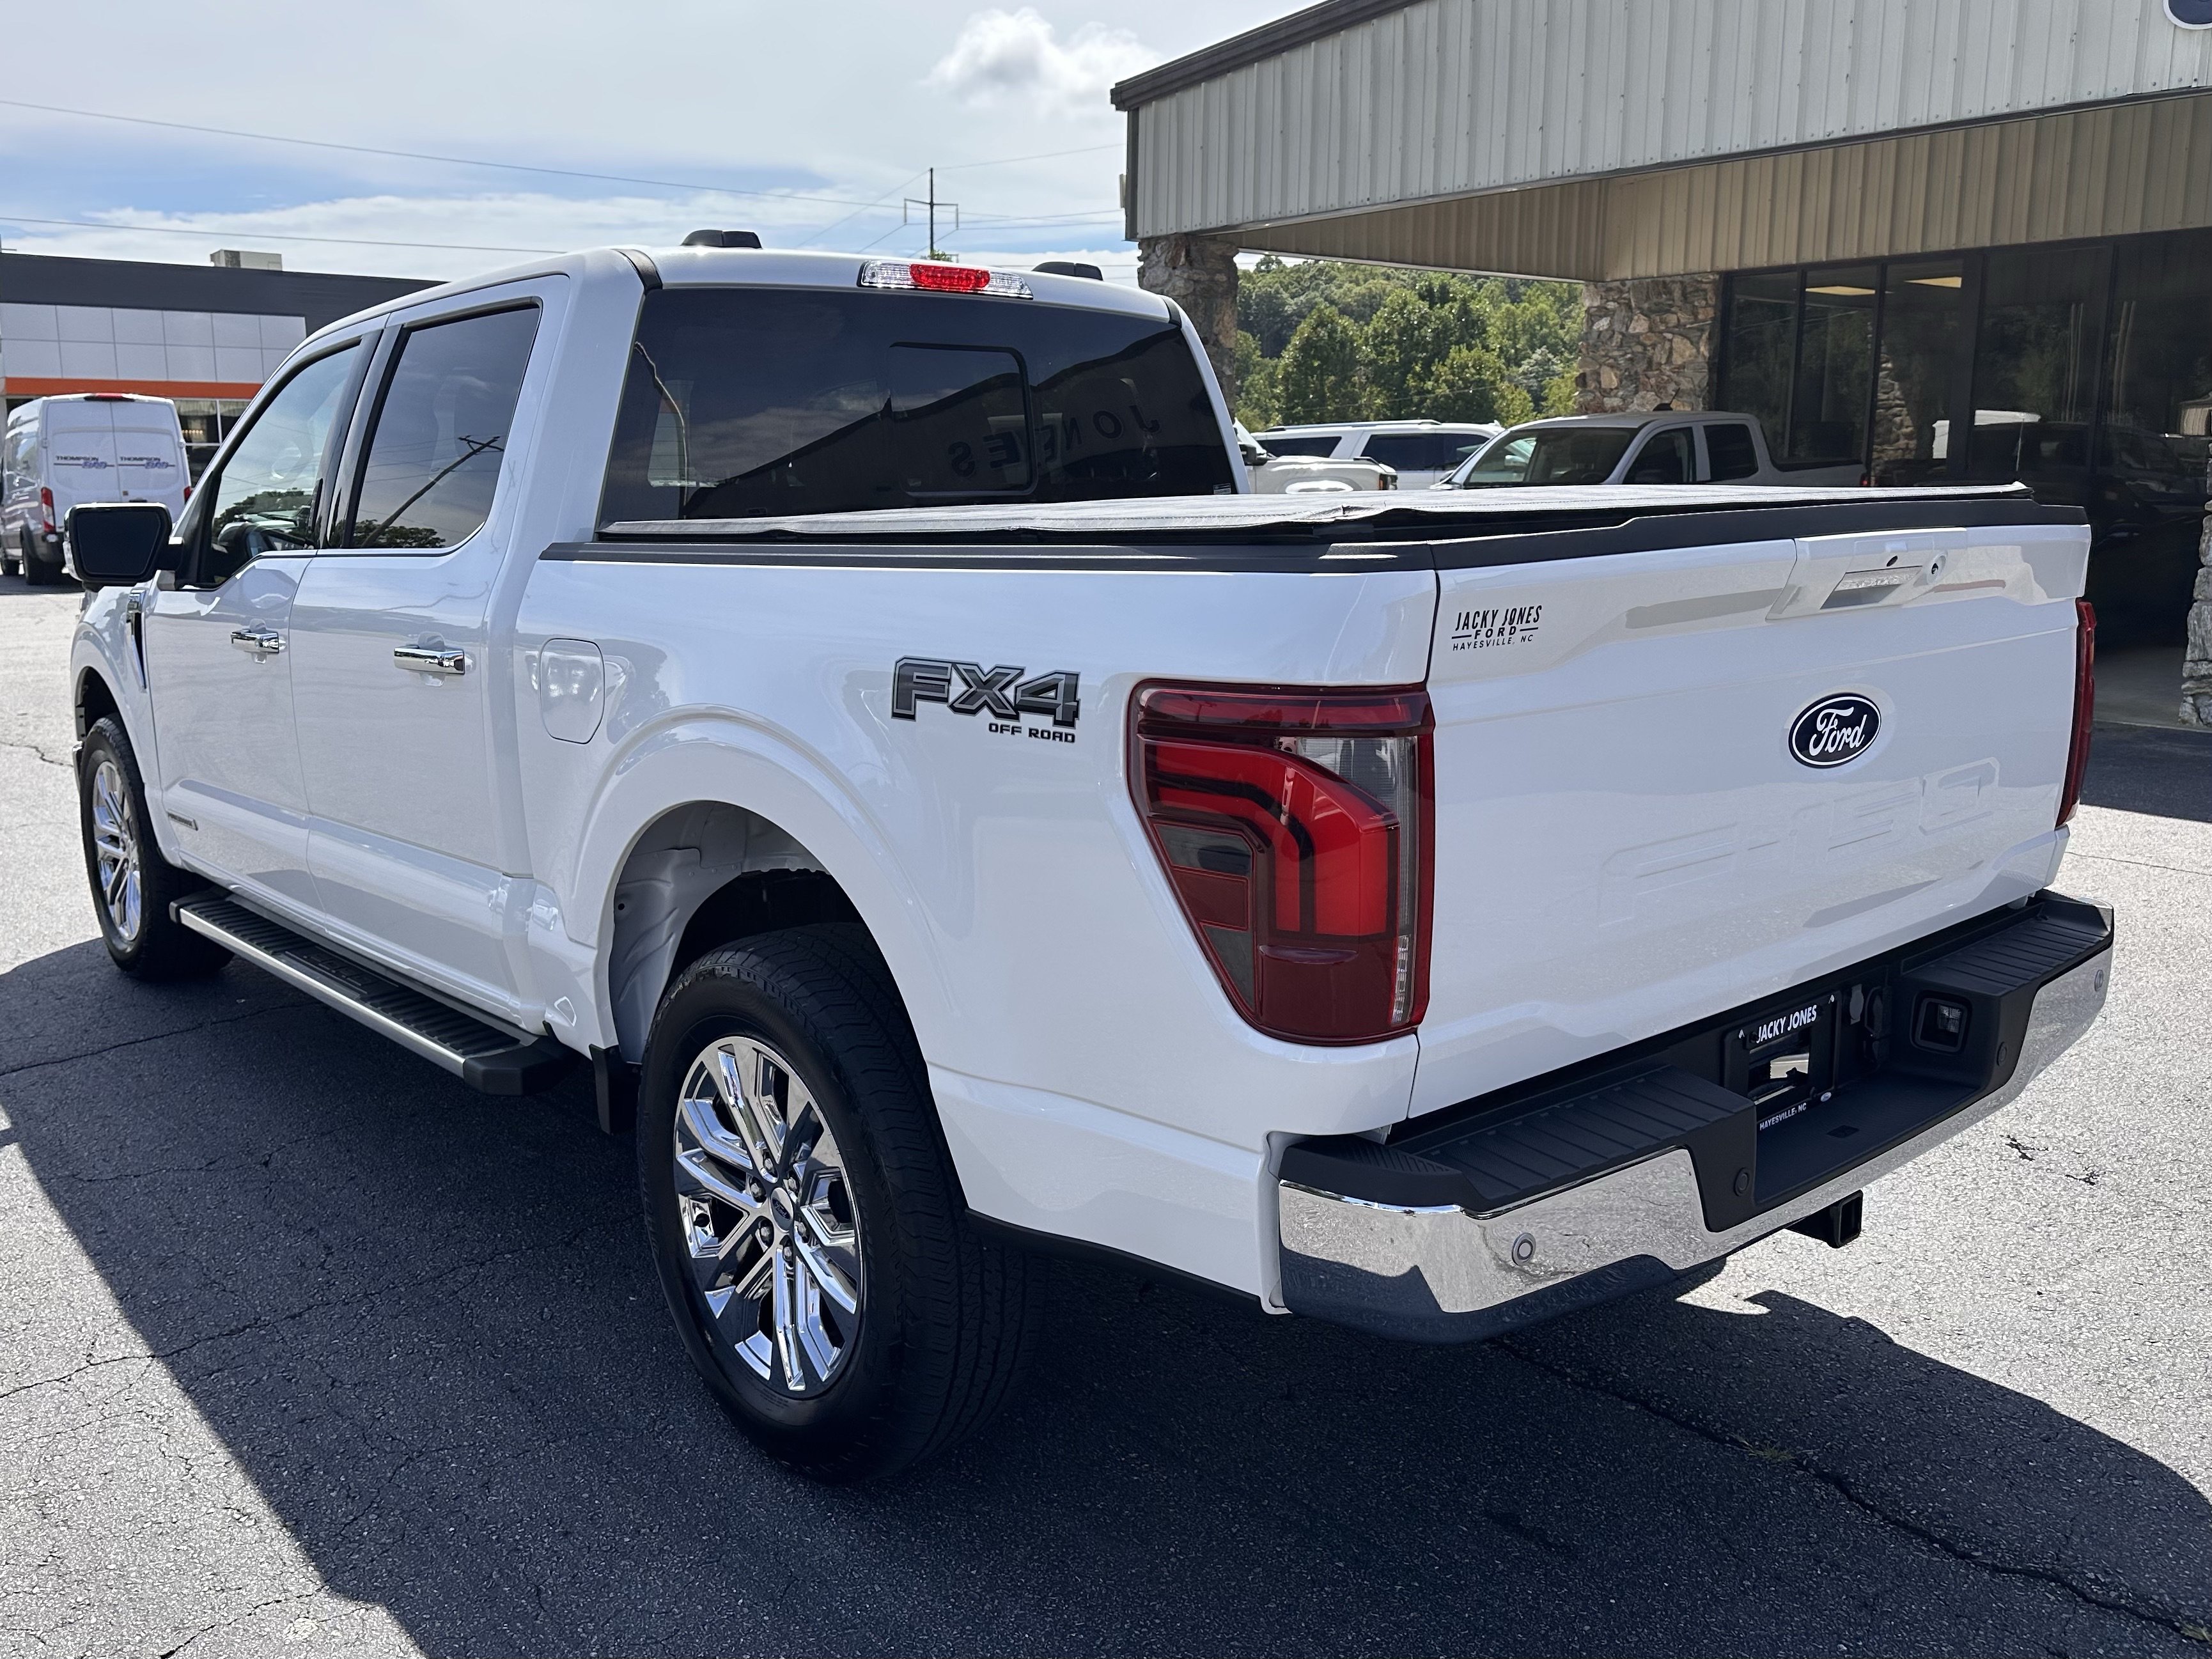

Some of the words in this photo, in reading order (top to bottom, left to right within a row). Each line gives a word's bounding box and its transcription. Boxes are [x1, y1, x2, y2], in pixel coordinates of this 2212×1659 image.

[1455, 609, 1499, 631] JACKY
[1502, 605, 1542, 627] JONES
[1474, 626, 1516, 639] FORD
[1521, 634, 1534, 643] NC
[891, 655, 1081, 729] FX4
[988, 722, 1022, 735] OFF
[1028, 727, 1075, 743] ROAD
[1809, 706, 1867, 756] Ford
[1756, 1016, 1786, 1043] JACKY
[1788, 1004, 1817, 1031] JONES
[1798, 1102, 1807, 1113] NC
